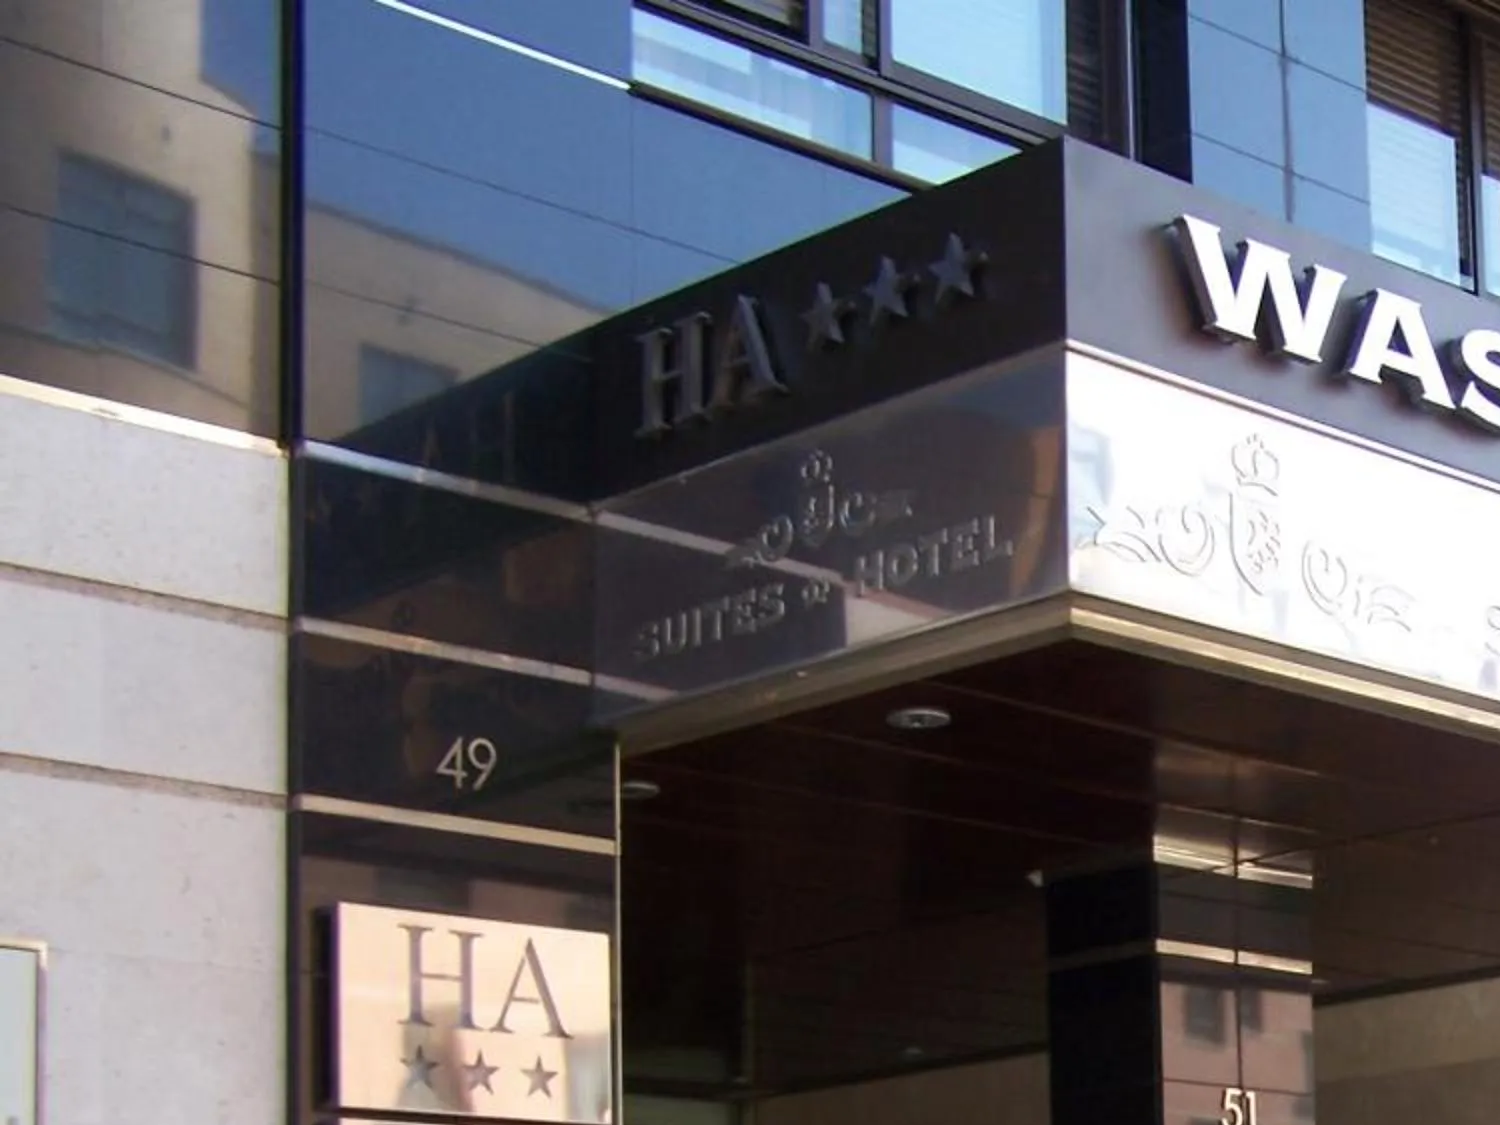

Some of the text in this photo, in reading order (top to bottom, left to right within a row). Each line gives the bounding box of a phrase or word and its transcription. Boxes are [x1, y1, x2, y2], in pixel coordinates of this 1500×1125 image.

[634, 293, 791, 439] HA
[634, 583, 785, 658] SUITES
[856, 515, 1013, 597] HOTEL
[437, 736, 497, 790] 49
[397, 923, 574, 1040] HA
